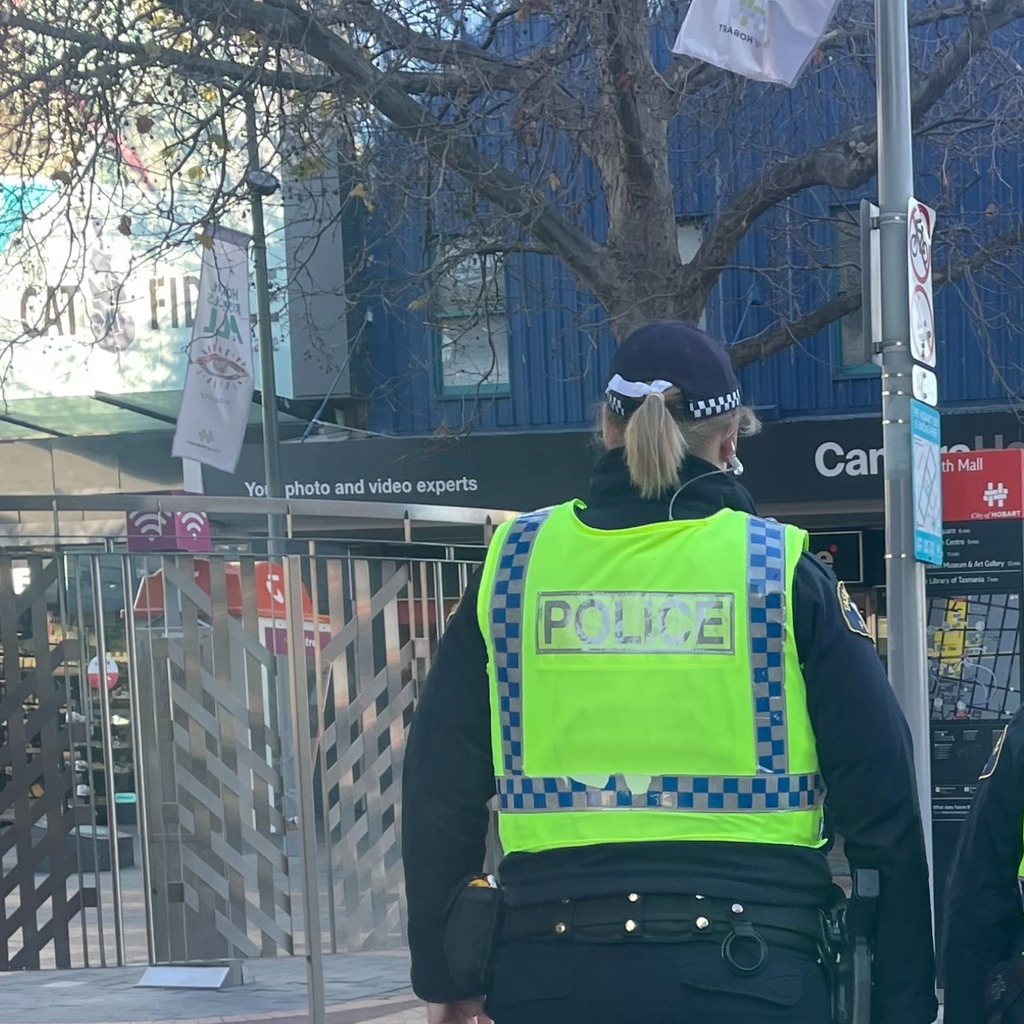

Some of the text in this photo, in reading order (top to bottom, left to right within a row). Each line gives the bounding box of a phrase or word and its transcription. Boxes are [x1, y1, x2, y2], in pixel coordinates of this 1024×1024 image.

[957, 457, 984, 471] Mall
[284, 480, 331, 499] photo
[334, 479, 365, 495] and
[368, 477, 412, 494] video
[416, 476, 478, 495] experts
[991, 510, 1022, 518] HOBART
[943, 561, 967, 569] Museum
[973, 560, 984, 568] Art
[984, 560, 1005, 568] Gallery
[929, 577, 950, 585] Library
[957, 576, 985, 584] Tasmania
[543, 598, 724, 645] POLICE
